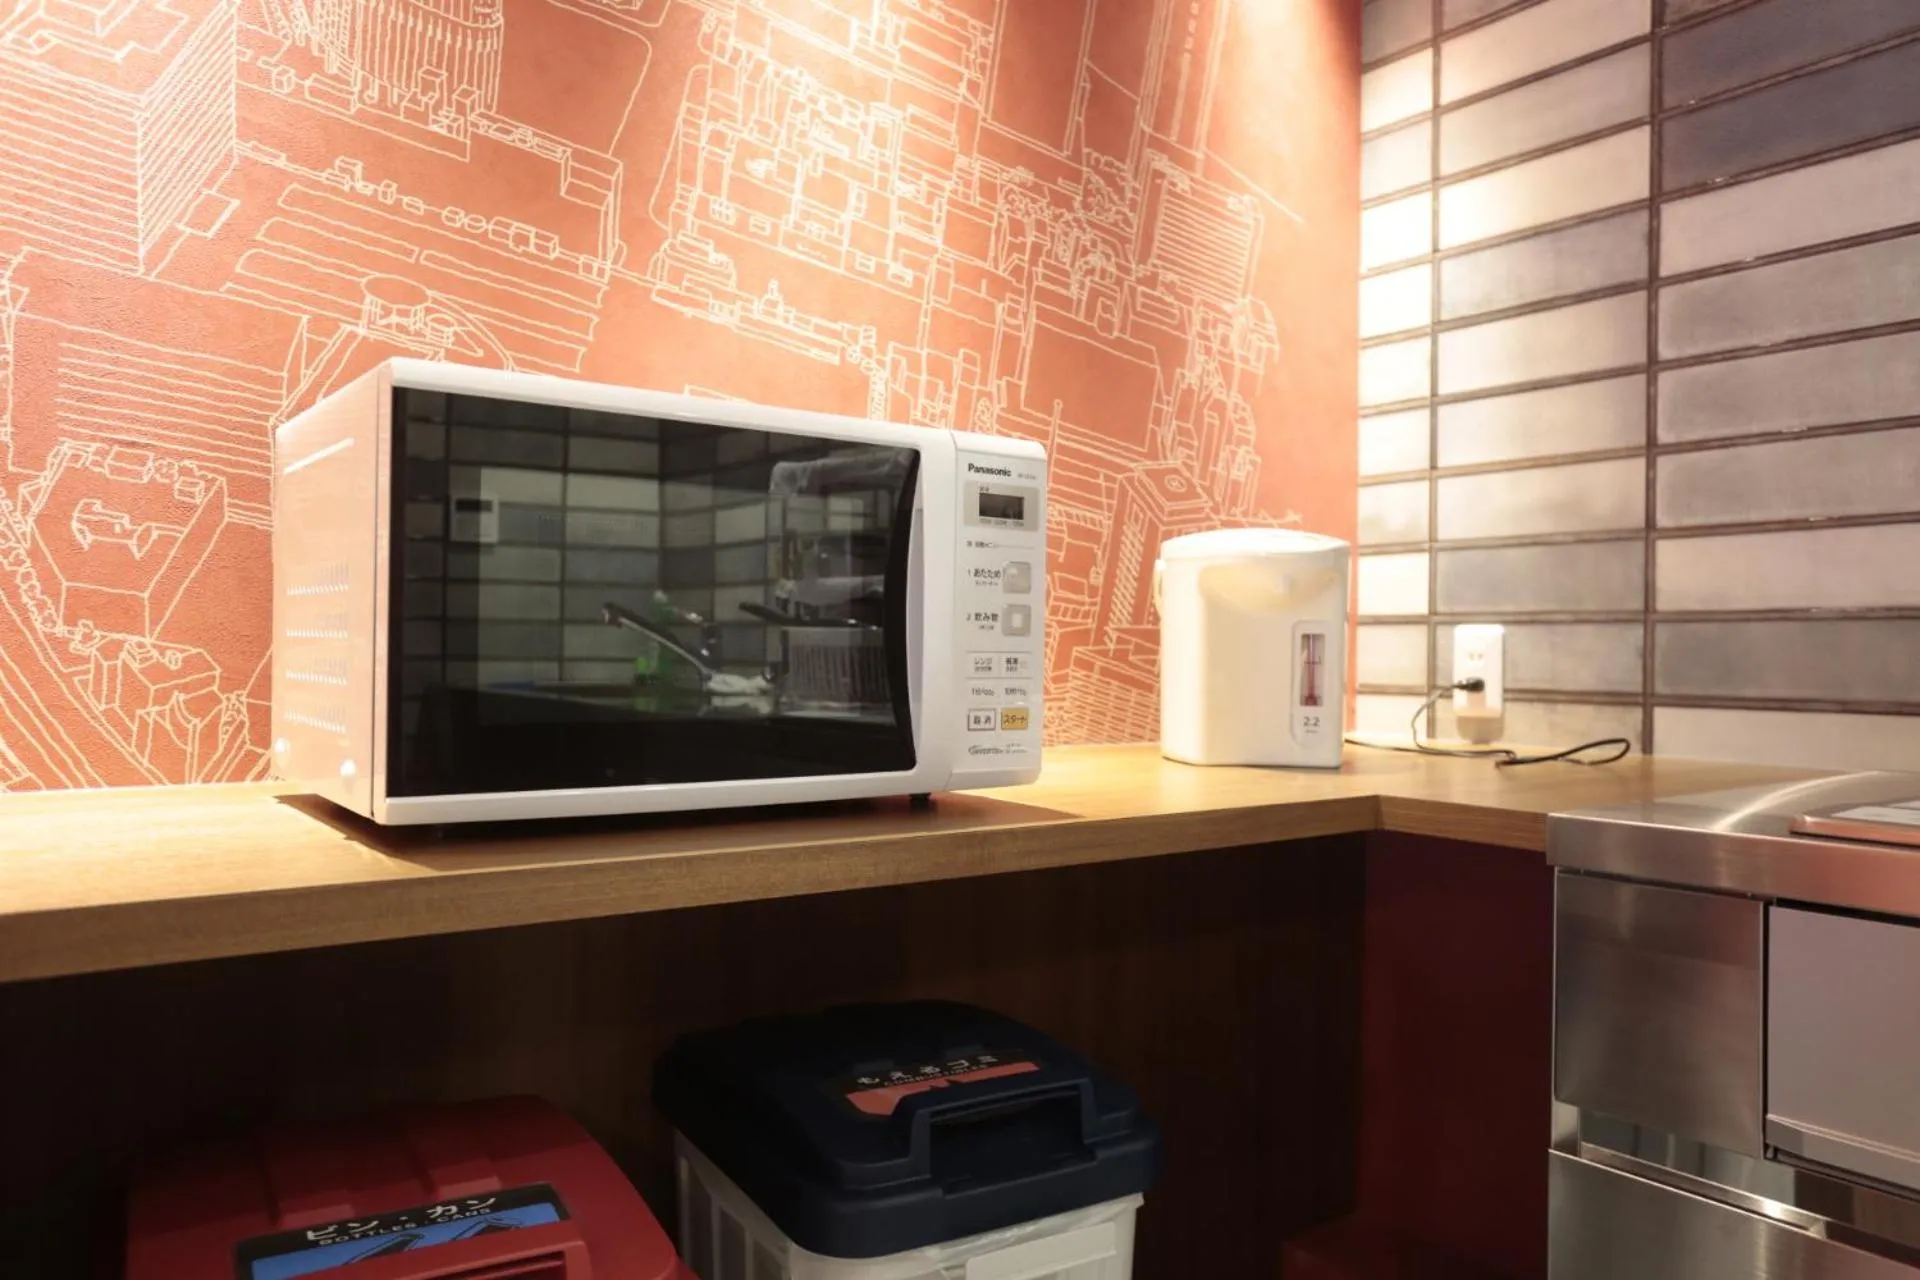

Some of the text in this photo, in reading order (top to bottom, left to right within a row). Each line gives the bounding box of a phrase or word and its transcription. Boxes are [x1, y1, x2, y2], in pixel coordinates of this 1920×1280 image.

[968, 463, 1012, 477] Panasonic
[974, 568, 1001, 579] あたため
[318, 1207, 492, 1246] BOTTLES CANS
